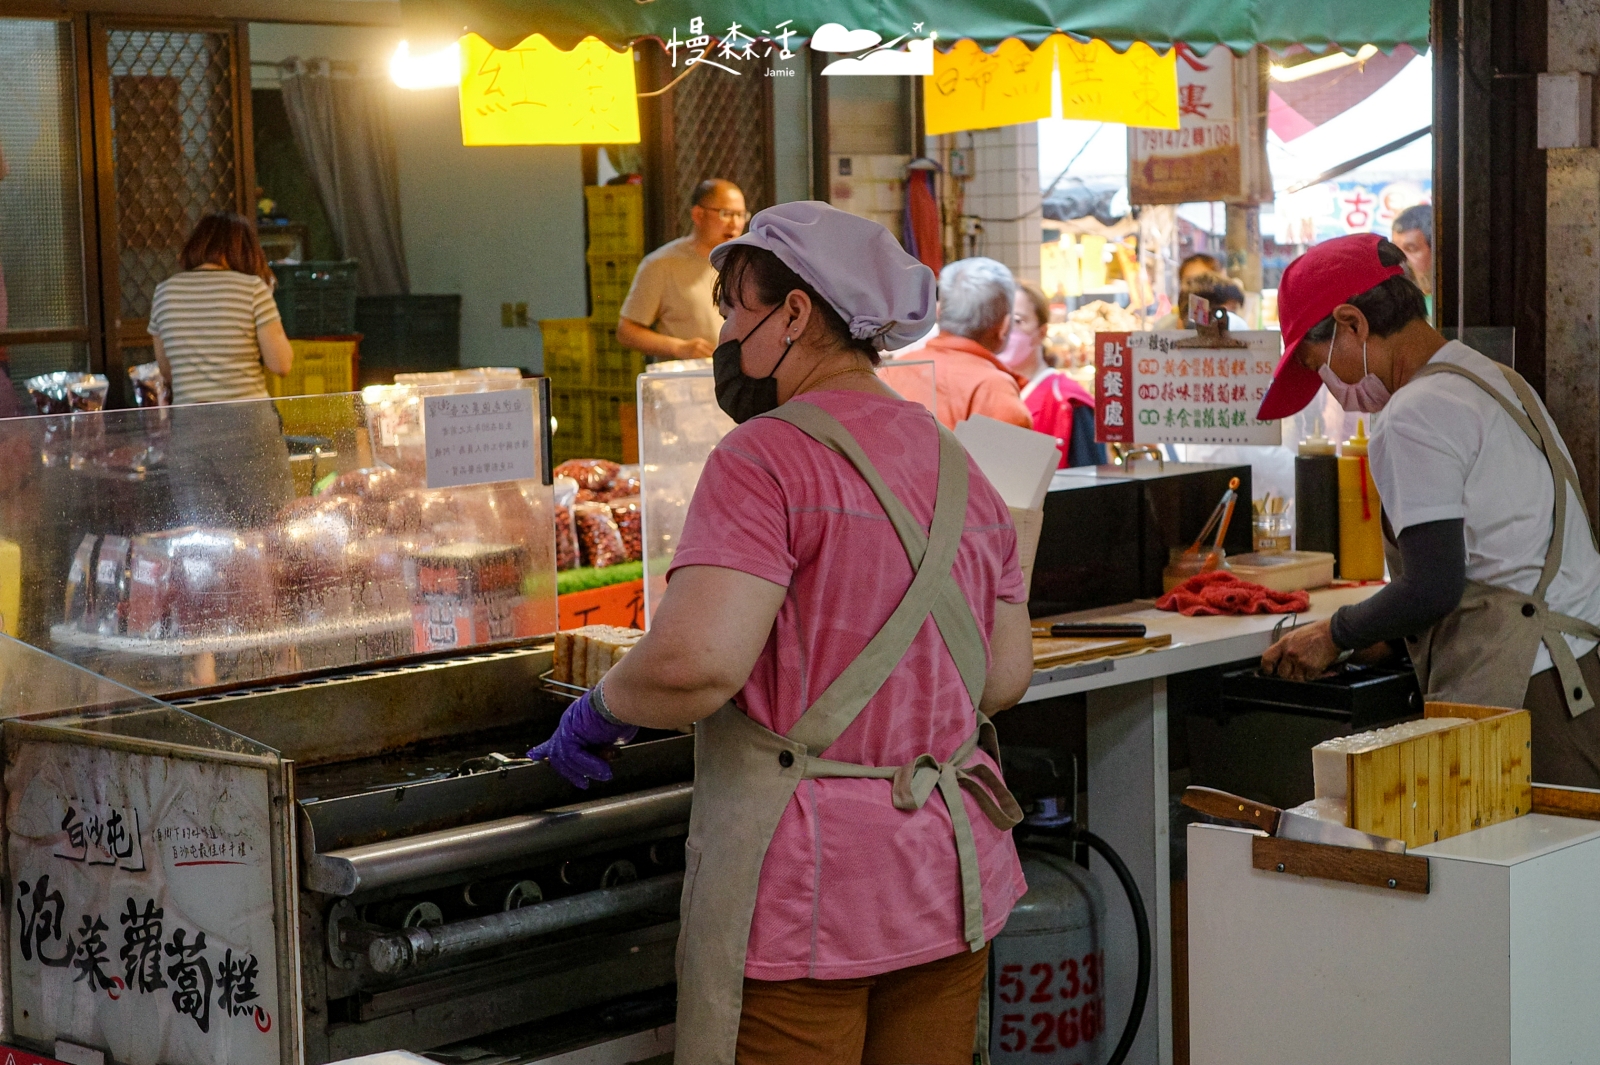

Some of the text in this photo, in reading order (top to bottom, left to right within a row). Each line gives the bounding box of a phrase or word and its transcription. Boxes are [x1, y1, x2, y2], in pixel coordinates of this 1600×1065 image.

[1068, 41, 1167, 121] 黑棗
[1102, 341, 1125, 427] 點餐處
[17, 874, 265, 1034] 泡菜蘿蔔糕
